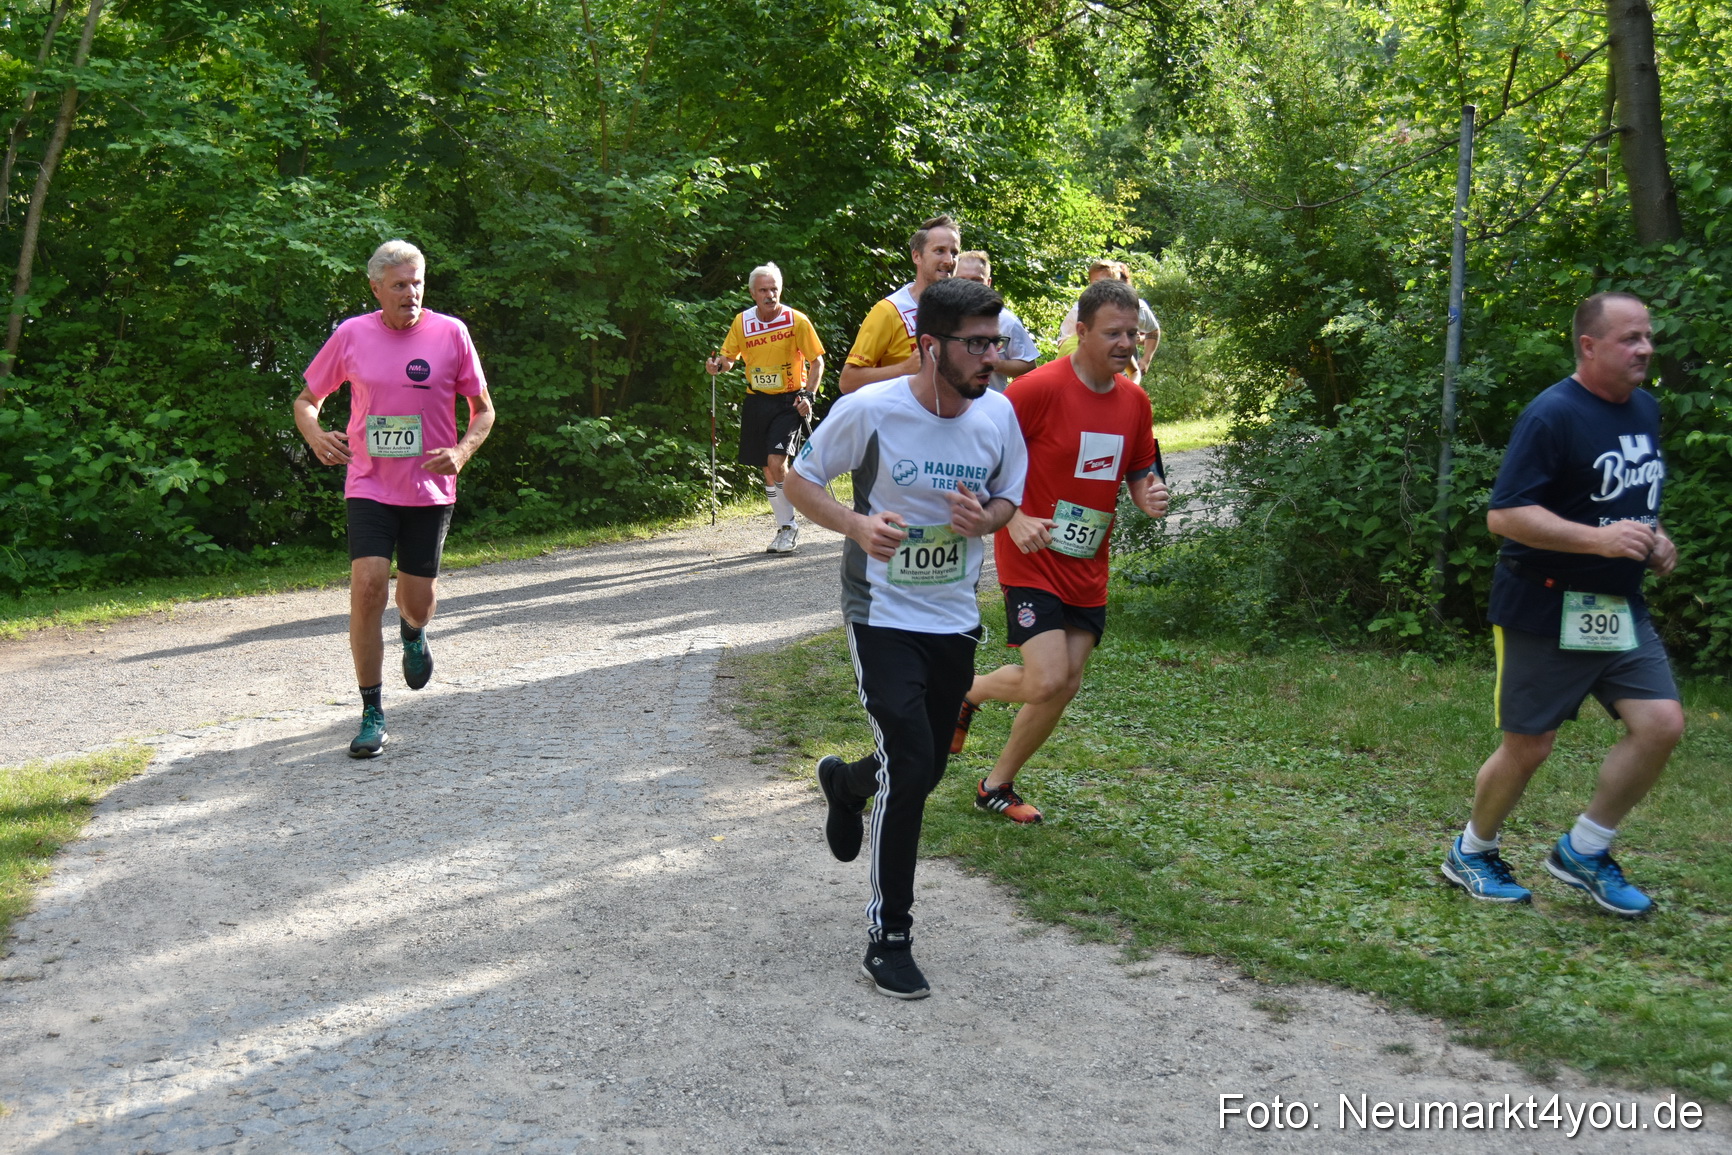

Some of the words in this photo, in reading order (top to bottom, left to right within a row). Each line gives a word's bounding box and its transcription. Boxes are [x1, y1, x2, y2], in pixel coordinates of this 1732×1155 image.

[745, 337, 768, 349] MAX
[770, 330, 796, 342] BÖGL
[754, 374, 778, 384] 1537
[373, 430, 415, 446] 1770
[924, 461, 988, 480] HAUBNER
[1064, 522, 1097, 546] 551
[900, 543, 959, 569] 1004
[1578, 613, 1620, 635] 390
